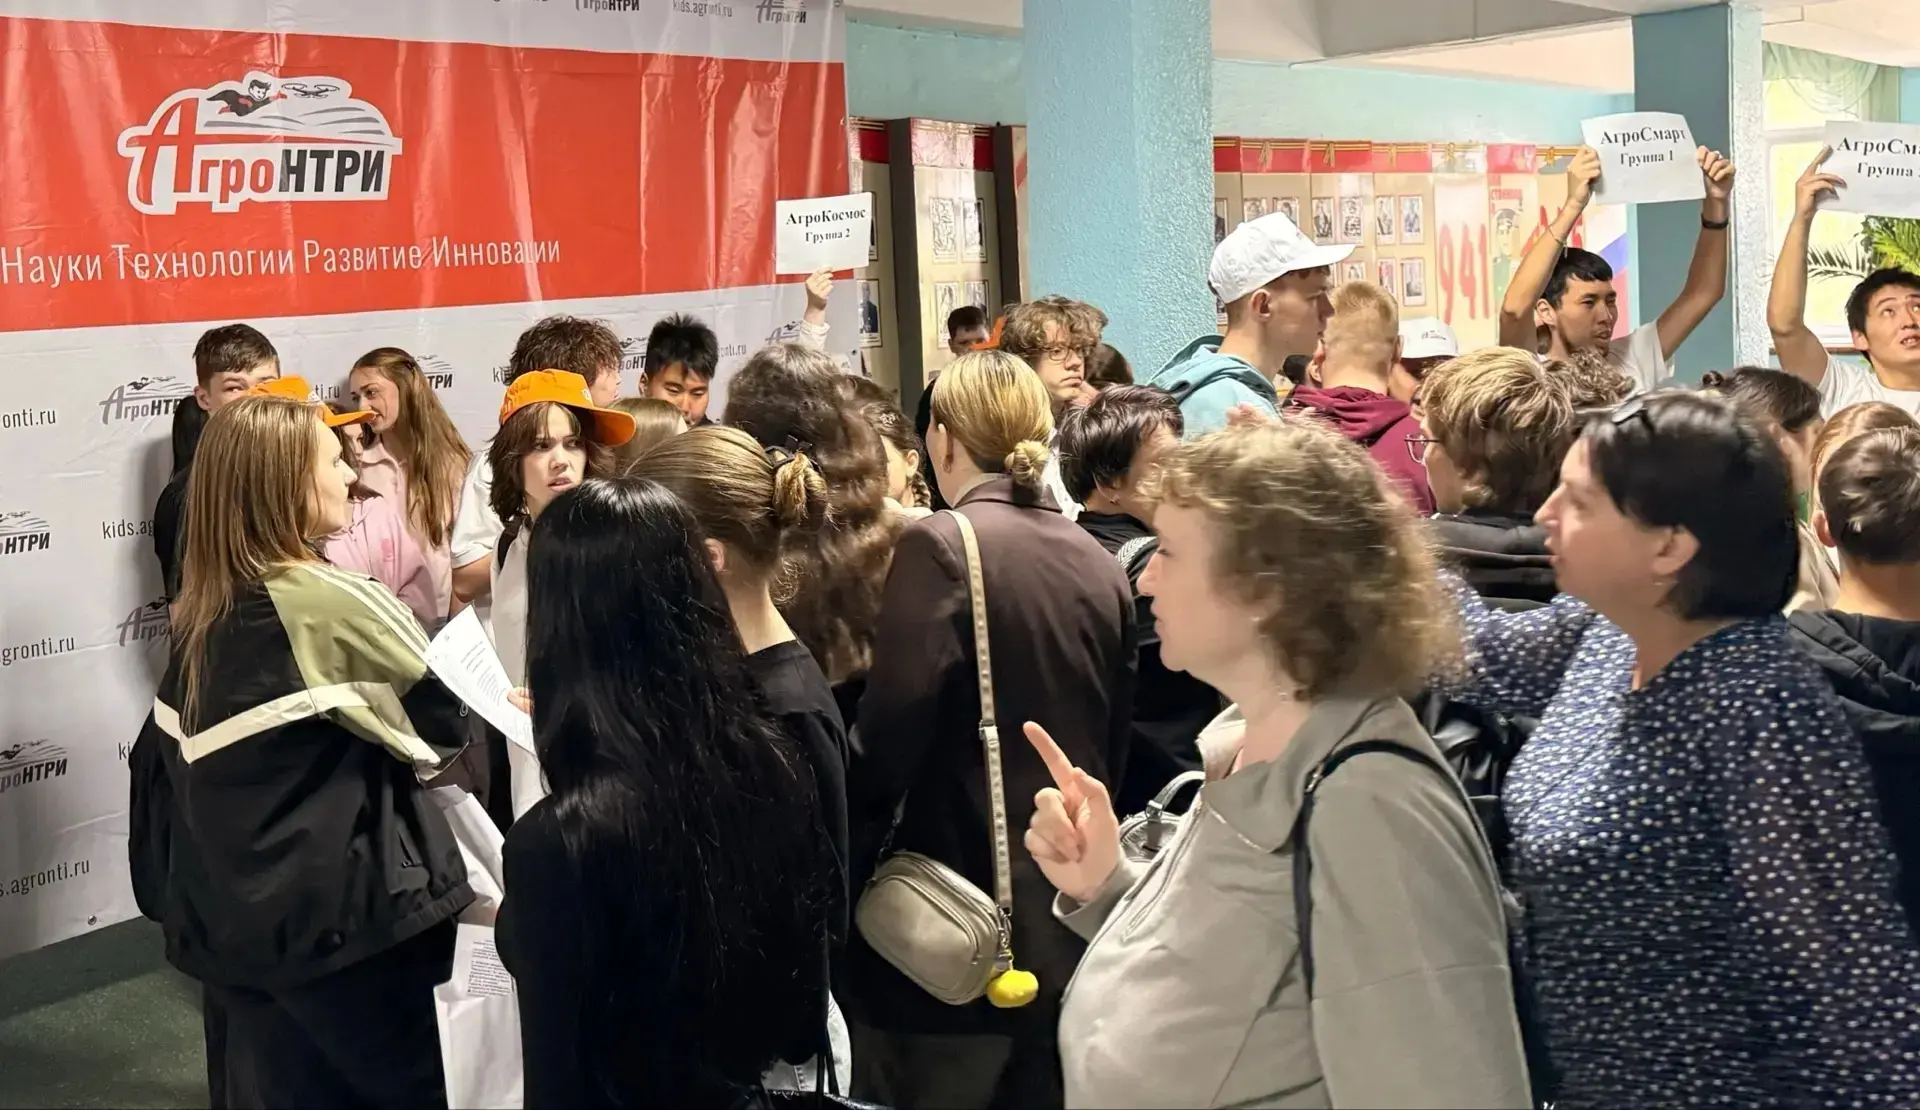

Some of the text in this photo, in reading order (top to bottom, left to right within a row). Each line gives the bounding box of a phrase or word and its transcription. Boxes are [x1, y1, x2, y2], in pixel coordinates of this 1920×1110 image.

[126, 97, 386, 206] АгроНТРИ
[1837, 137, 1920, 156] АгроСм
[1620, 150, 1674, 167] Группа 1
[1857, 161, 1914, 178] Группа
[786, 209, 866, 227] АгроКосмос
[805, 228, 850, 244] Группа 2
[2, 235, 560, 288] Науки Технологии Развитие Инновации
[0, 532, 51, 555] НТРИ
[2, 637, 75, 667] gronti.ru
[0, 758, 68, 793] роНТРИ
